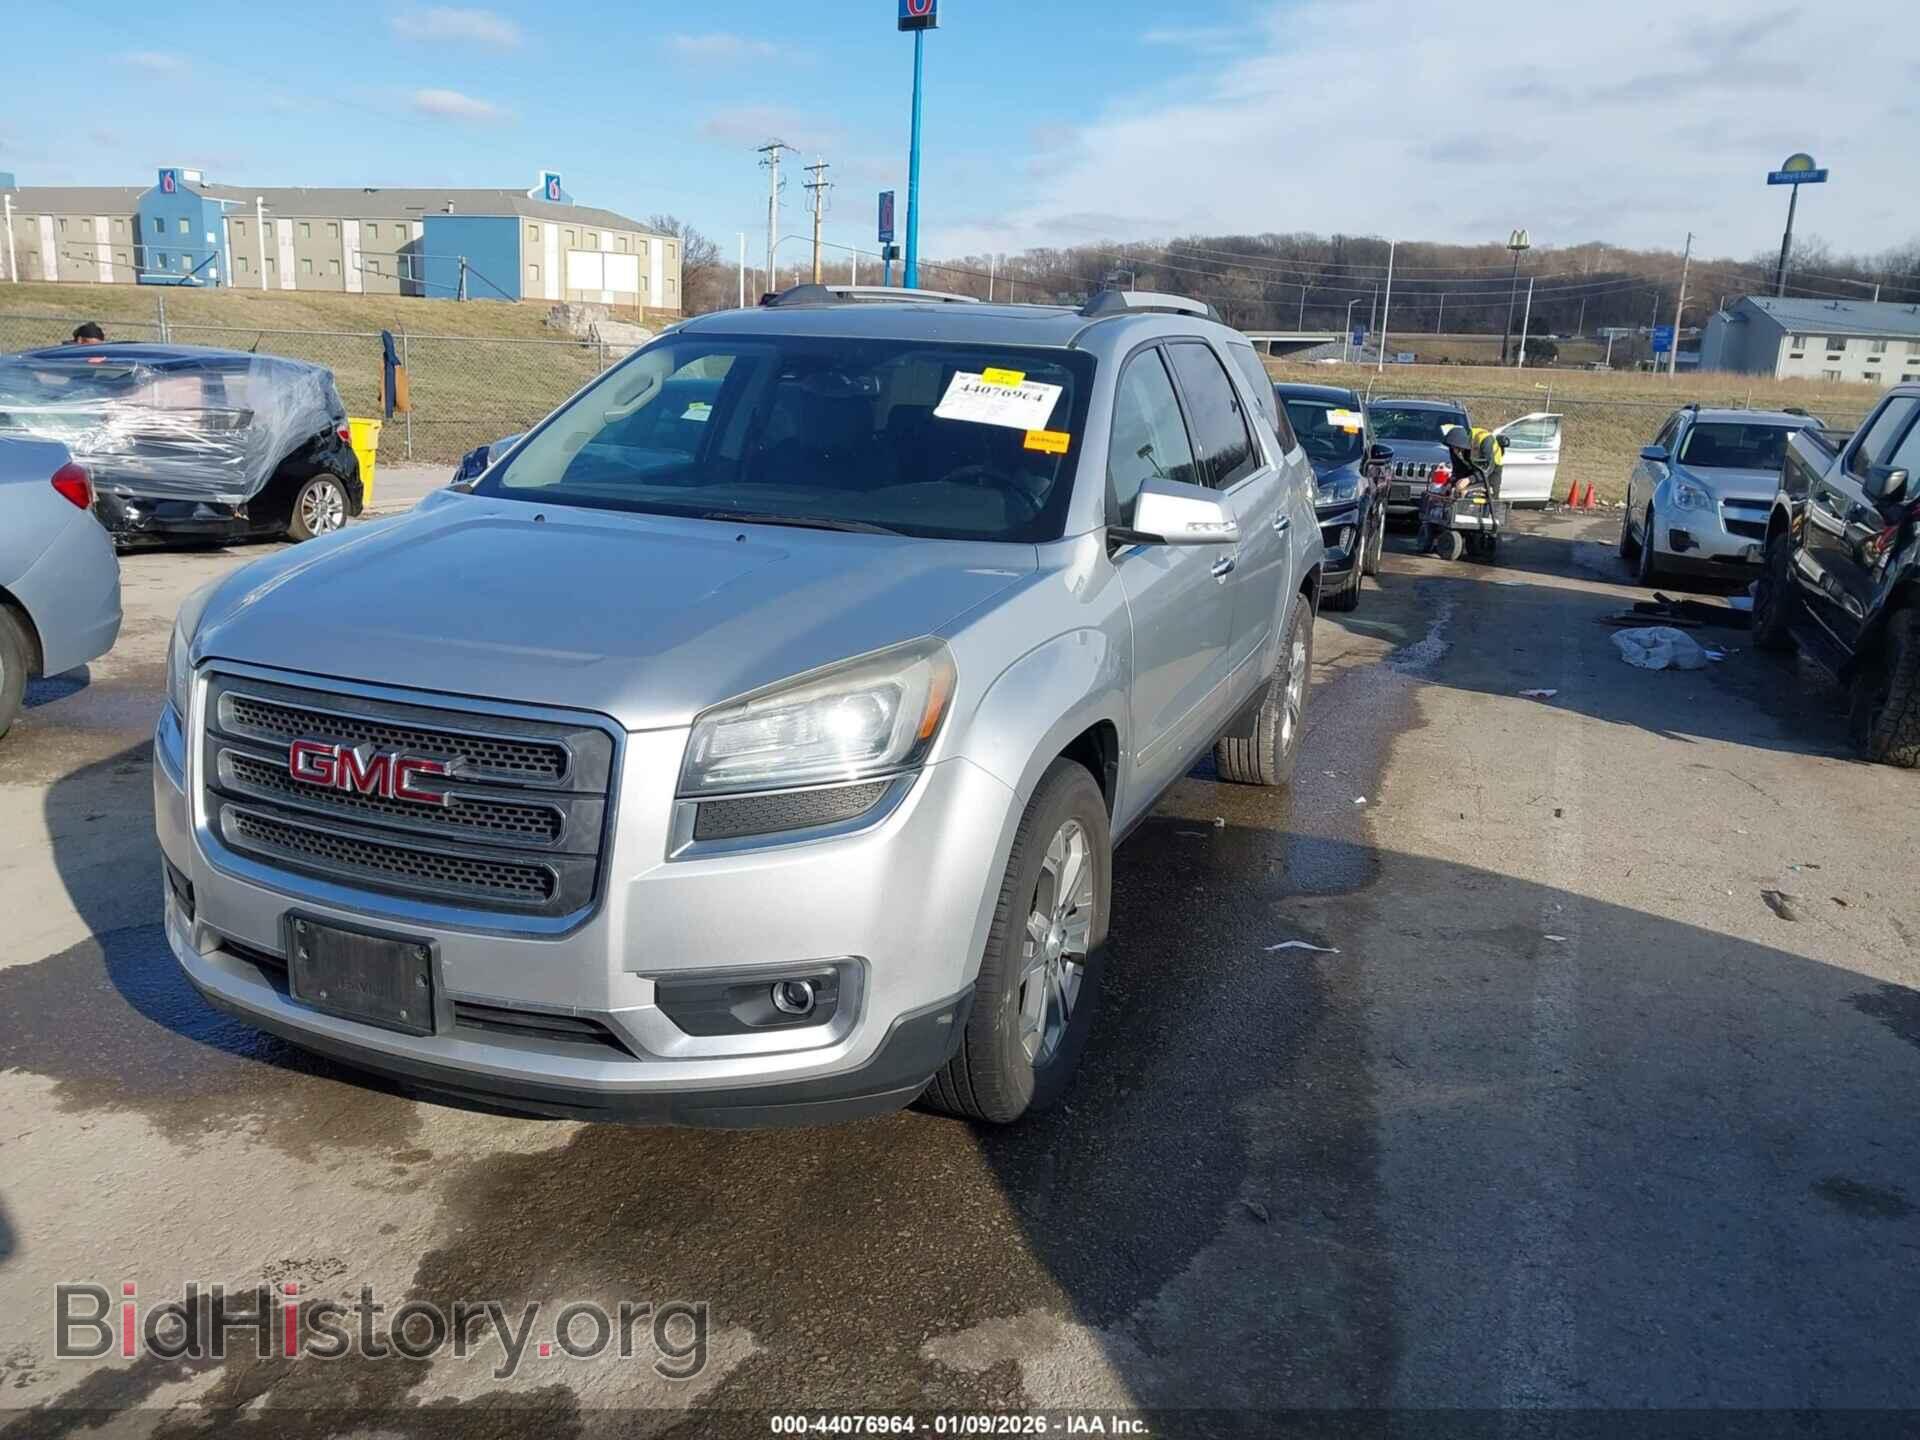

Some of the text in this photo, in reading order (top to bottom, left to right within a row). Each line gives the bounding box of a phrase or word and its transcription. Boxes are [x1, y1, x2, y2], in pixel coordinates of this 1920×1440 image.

[163, 171, 174, 193] 6
[549, 178, 560, 200] 6
[960, 383, 1044, 403] 44076964
[289, 739, 451, 807] GMC
